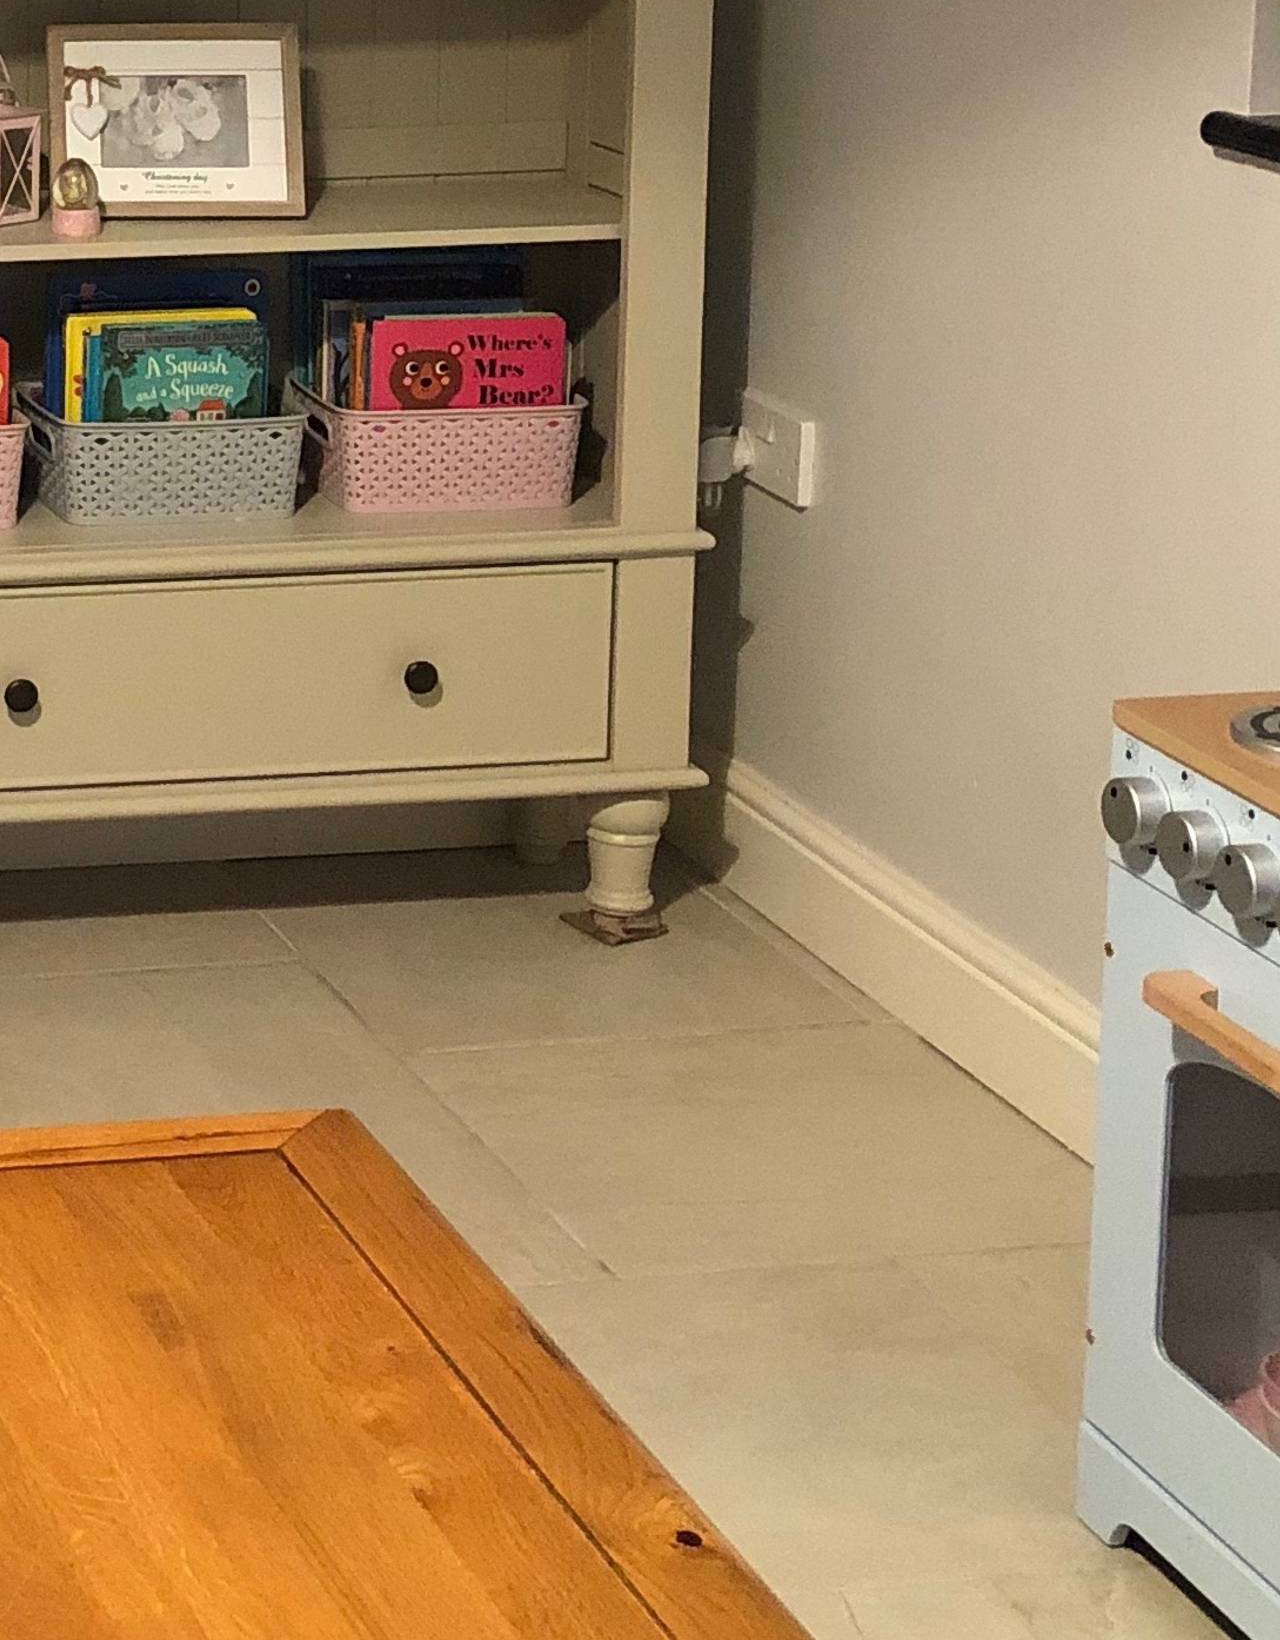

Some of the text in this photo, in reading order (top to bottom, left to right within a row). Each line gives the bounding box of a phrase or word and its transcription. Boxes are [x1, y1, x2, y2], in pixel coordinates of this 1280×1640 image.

[467, 334, 552, 351] Where's
[144, 353, 229, 381] A Squash
[473, 358, 524, 378] Mrs
[135, 378, 234, 403] and a Squeeze
[479, 384, 554, 405] Bear?
